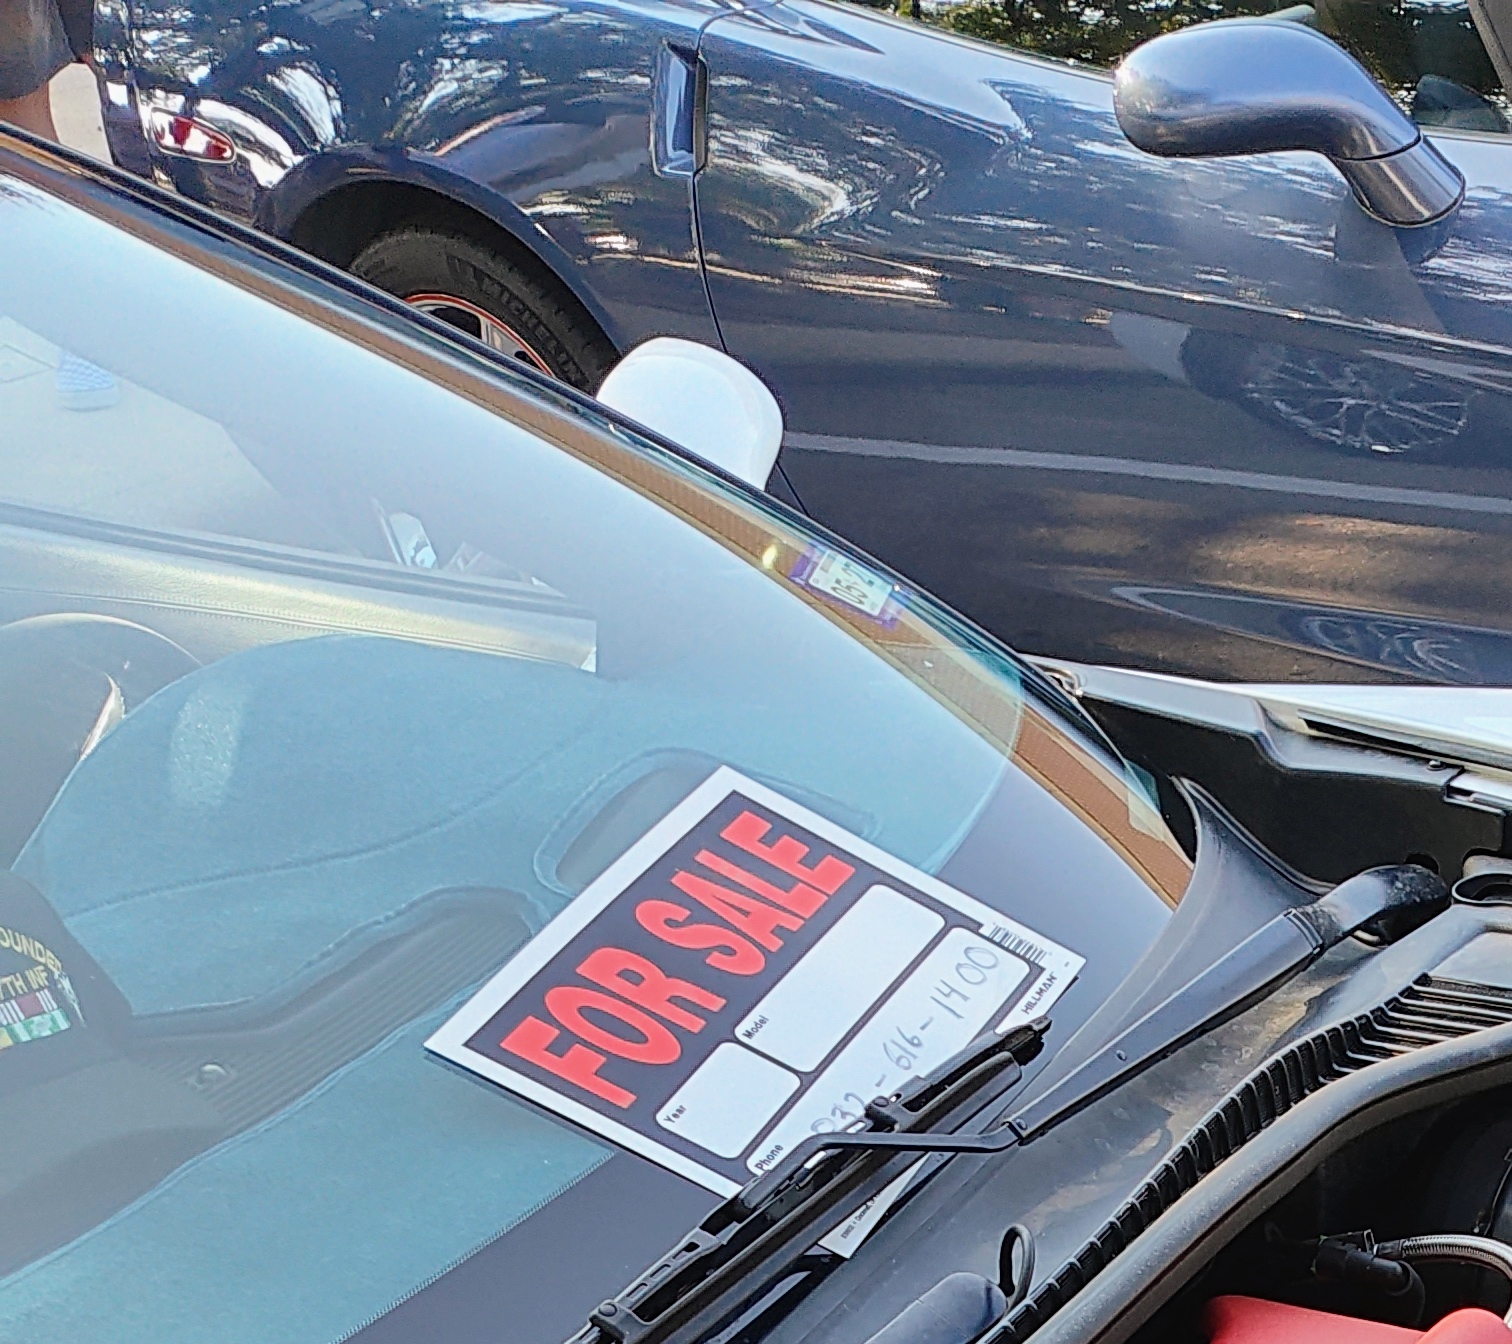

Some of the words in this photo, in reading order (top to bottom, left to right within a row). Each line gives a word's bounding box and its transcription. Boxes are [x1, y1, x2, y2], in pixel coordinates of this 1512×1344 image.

[499, 946, 728, 1110] FOR
[633, 810, 856, 976] SALE
[1020, 971, 1058, 1015] HILLMAN
[743, 1014, 770, 1041] Model
[663, 1103, 688, 1124] Year
[754, 1143, 785, 1172] Phone
